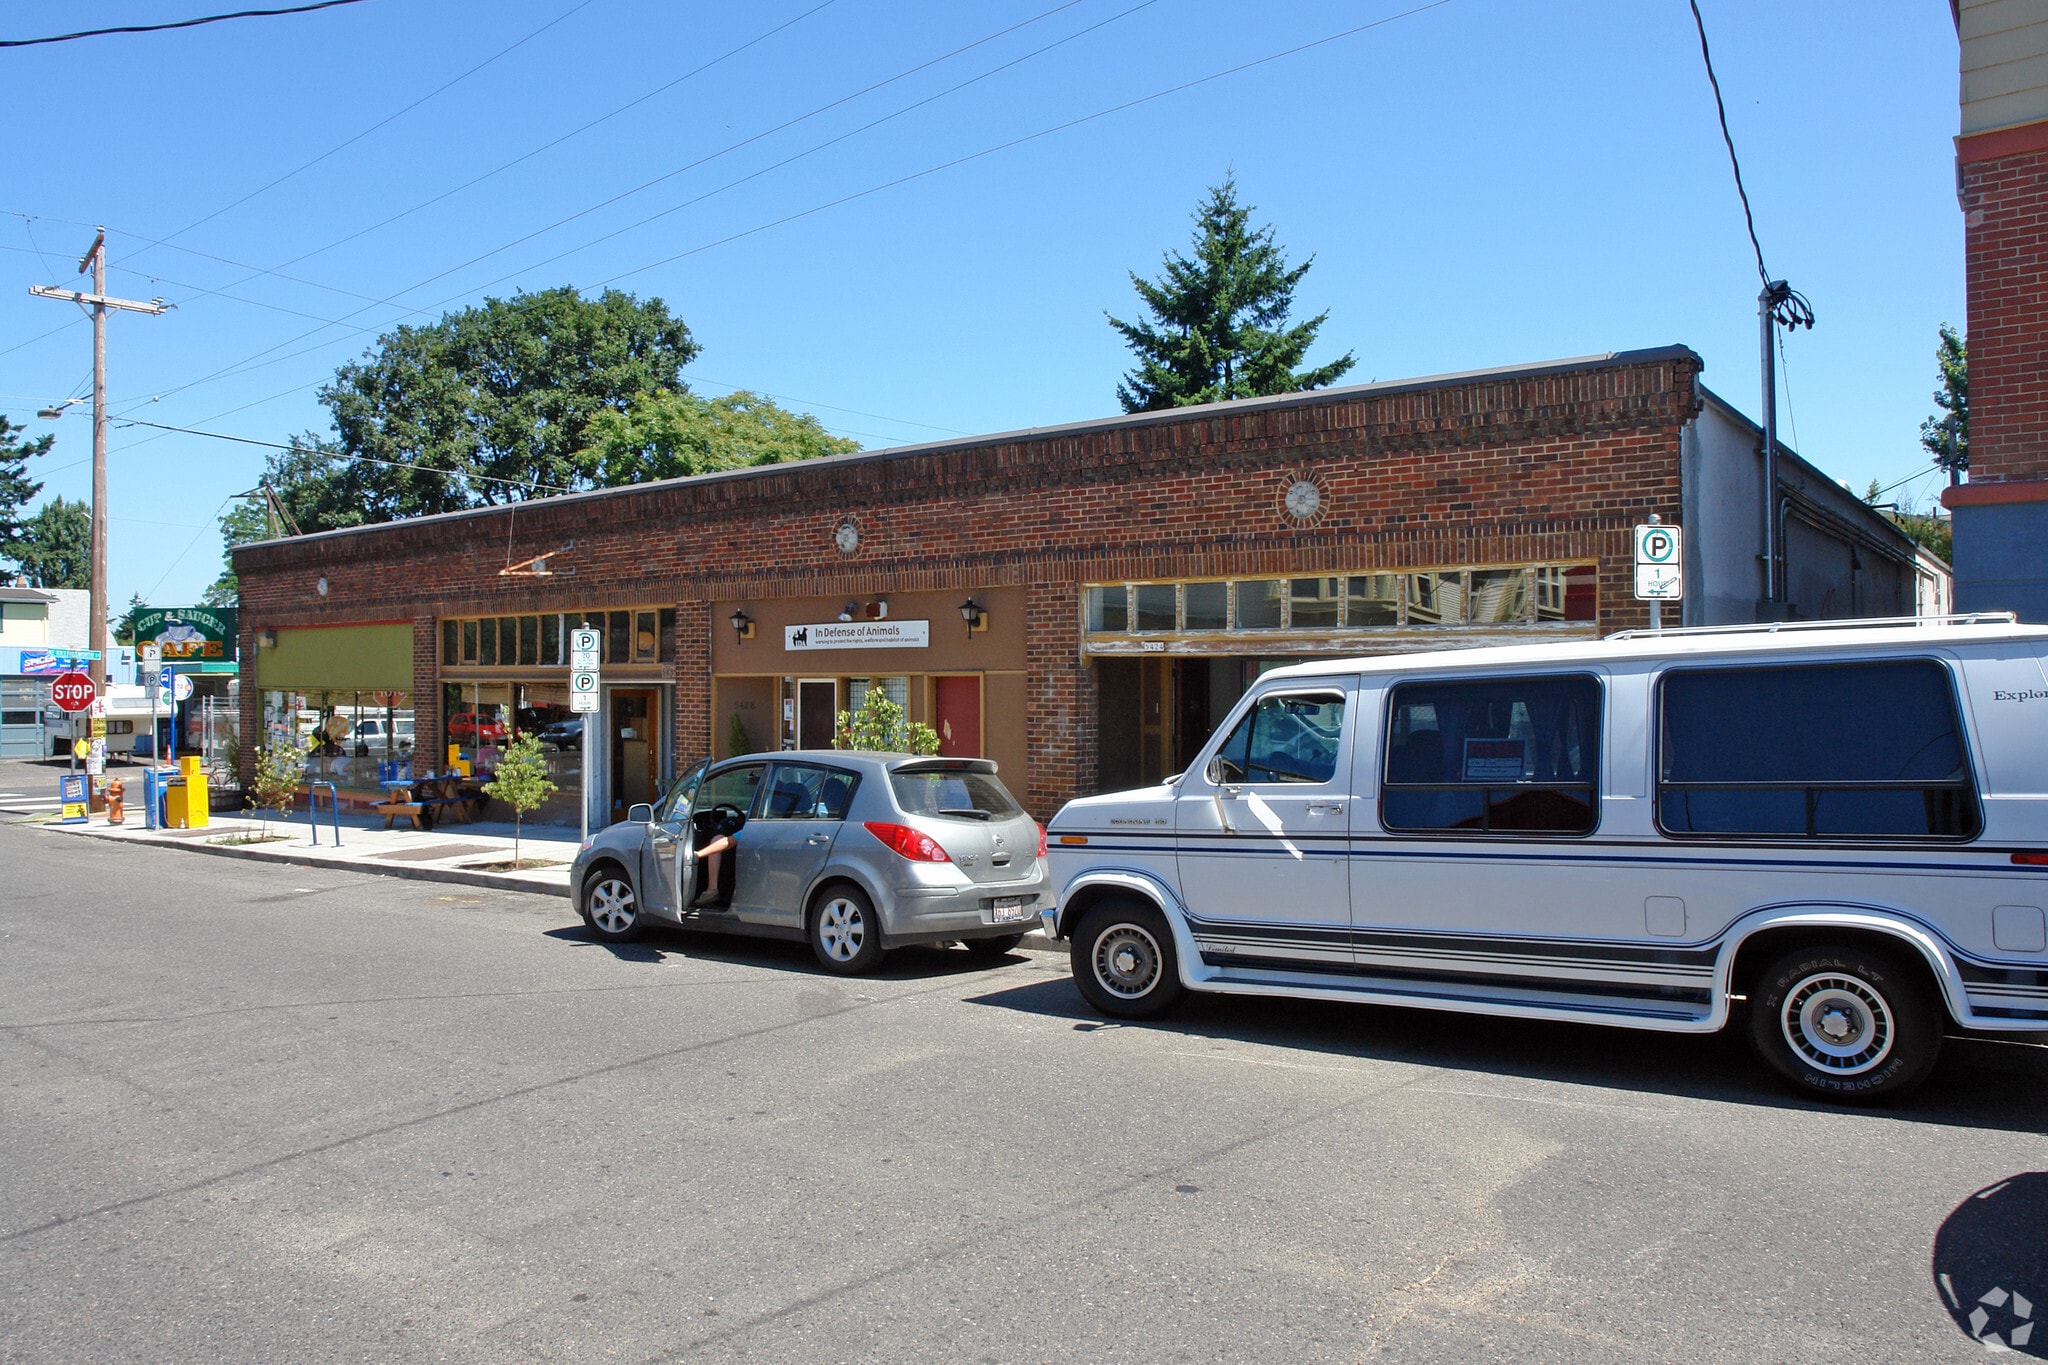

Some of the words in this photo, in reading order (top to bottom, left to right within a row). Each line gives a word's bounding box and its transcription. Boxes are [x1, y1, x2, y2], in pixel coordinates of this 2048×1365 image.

[1652, 537, 1667, 556] P
[1655, 568, 1660, 579] 1
[137, 612, 162, 632] CUP
[177, 609, 226, 636] SAUCER
[815, 628, 823, 638] In
[824, 626, 856, 638] Defense
[857, 626, 866, 637] of
[866, 625, 900, 636] Animals
[136, 640, 224, 658] CAFE
[581, 636, 591, 647] P
[581, 677, 591, 688] P
[54, 684, 93, 700] STOP
[1777, 959, 1847, 988] RADIAL
[1857, 964, 1884, 981] LT
[1804, 1058, 1904, 1091] MICHELIN
